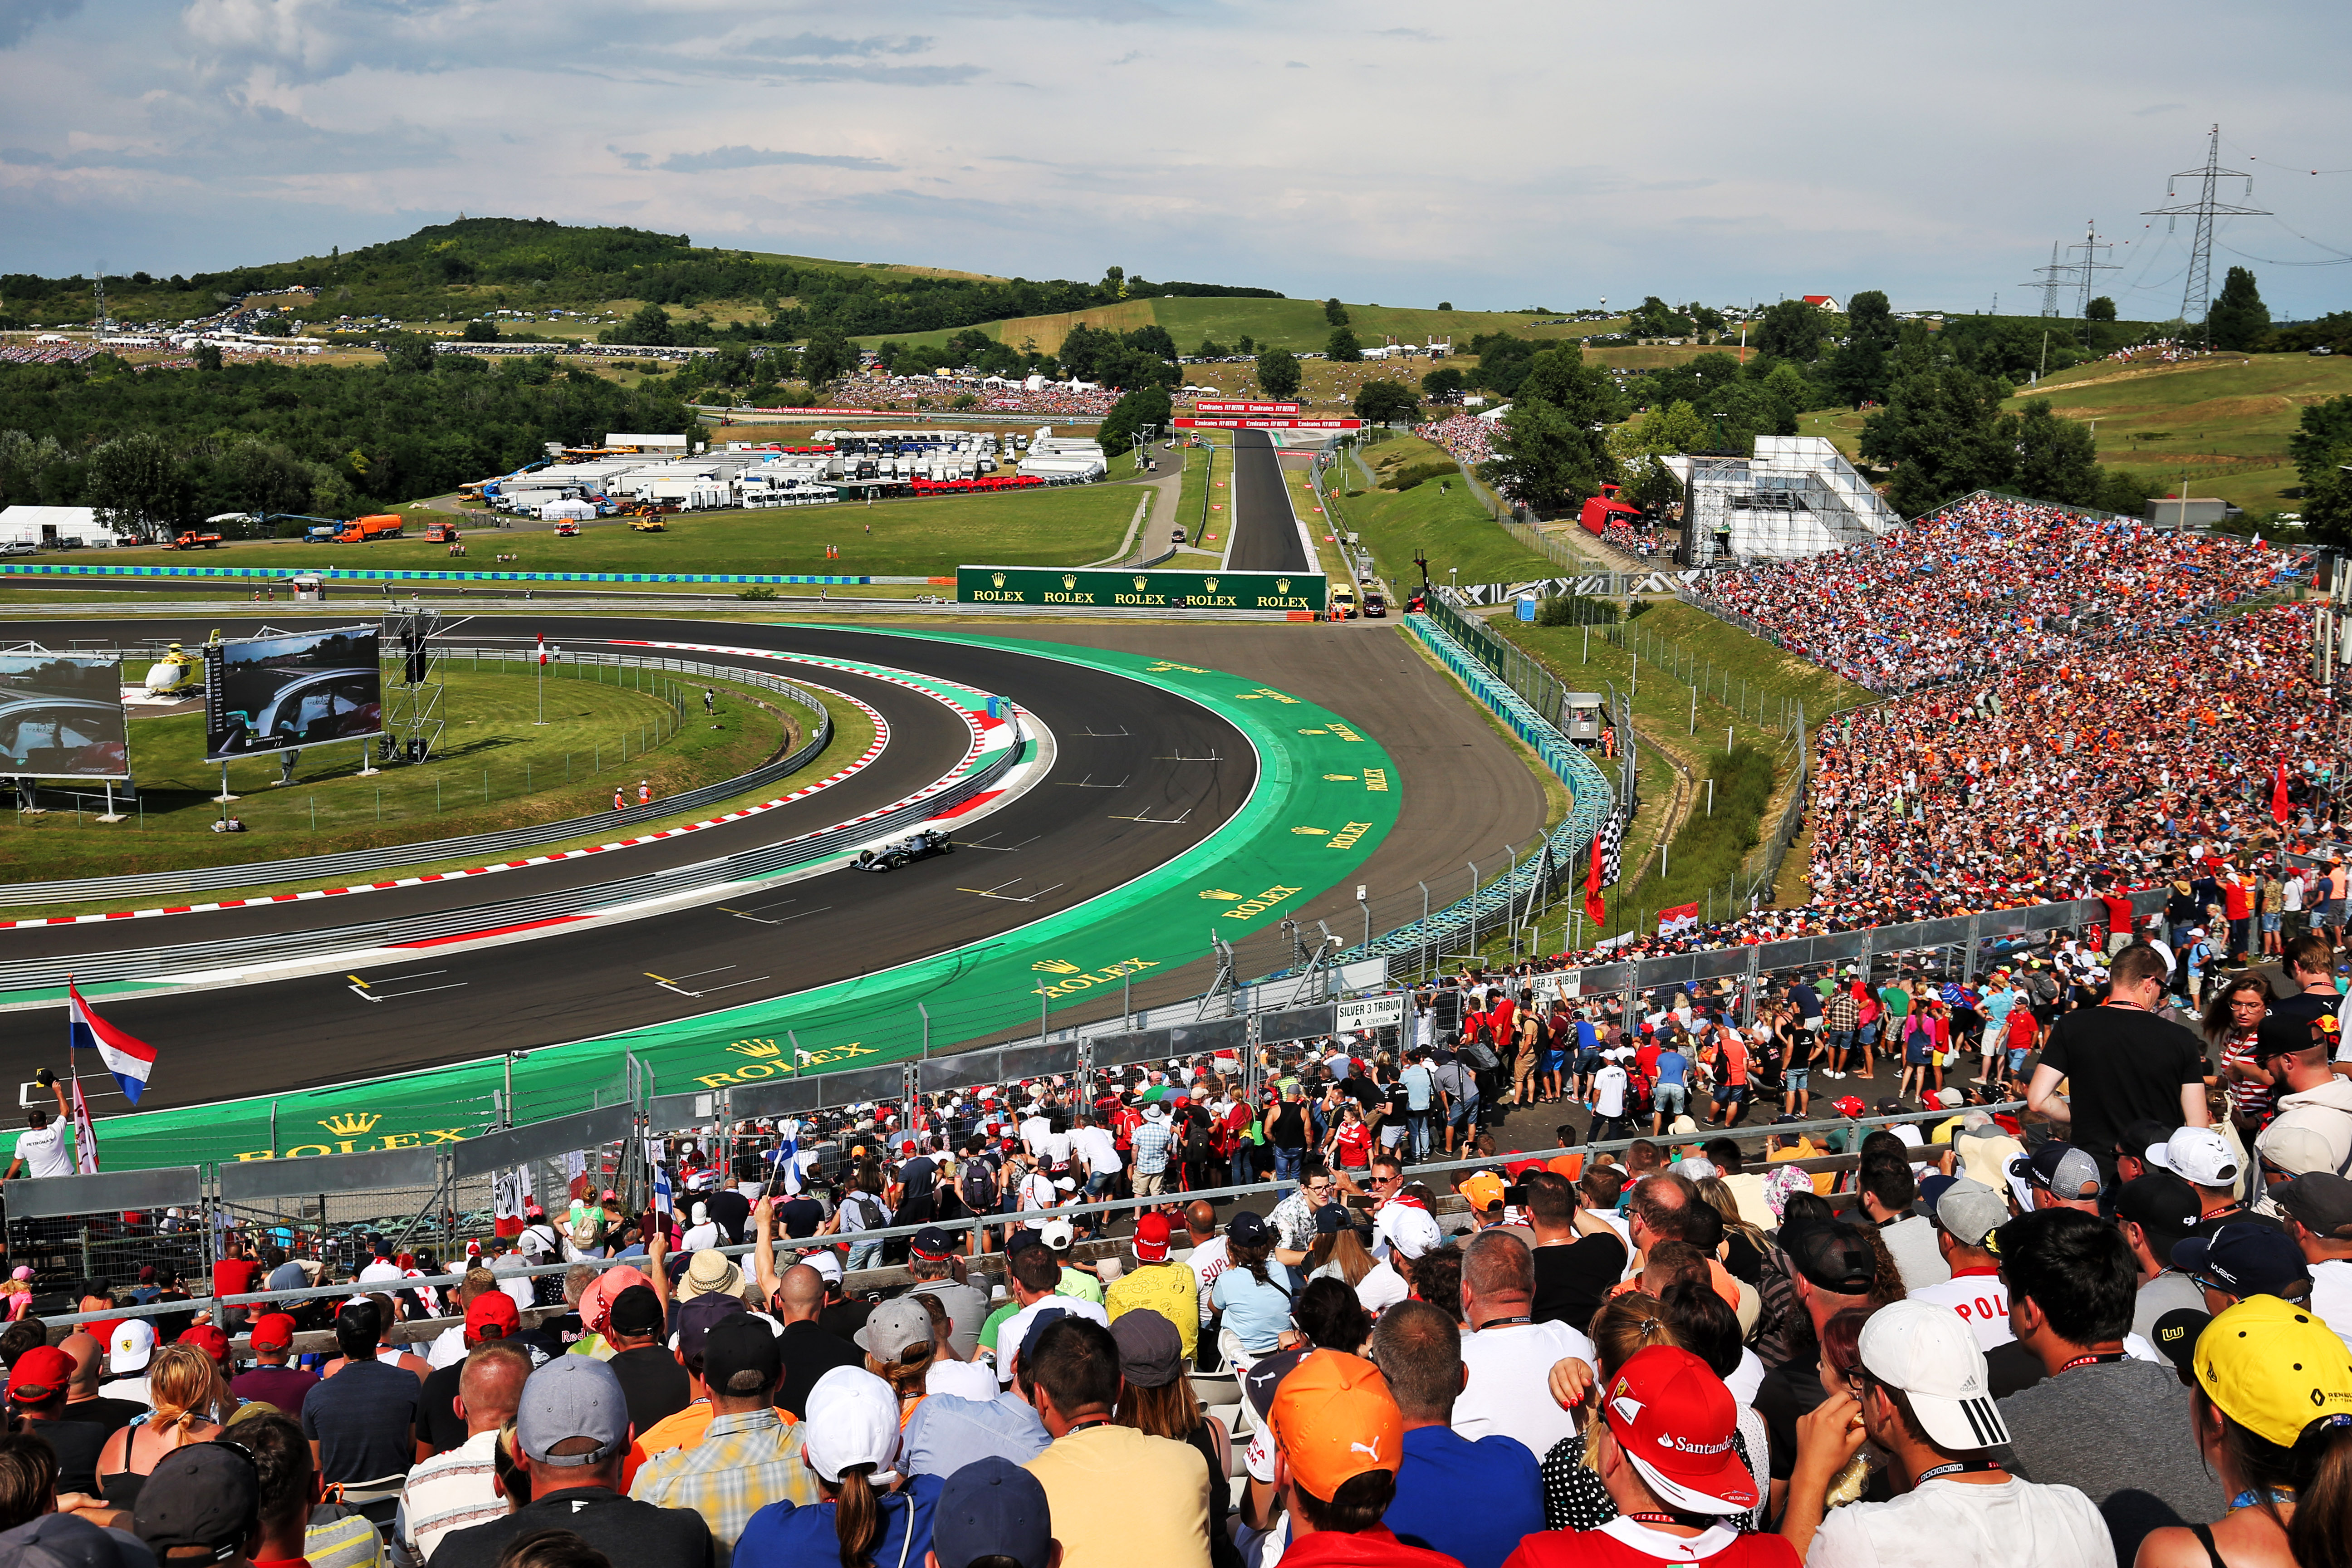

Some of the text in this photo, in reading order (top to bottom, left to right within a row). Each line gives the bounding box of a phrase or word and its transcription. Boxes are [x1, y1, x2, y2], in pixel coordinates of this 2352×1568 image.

[973, 590, 1024, 601] ROLEX
[1044, 592, 1095, 603] ROLEX
[1115, 593, 1166, 604] ROLEX
[1186, 595, 1237, 606] ROLEX
[1257, 596, 1308, 608] ROLEX
[1490, 661, 1498, 675] ROLEX
[1252, 688, 1301, 704] ROLEX
[1325, 723, 1364, 742] ROLEX
[1363, 768, 1389, 792] ROLEX
[1326, 821, 1372, 850] ROLEX
[1221, 885, 1303, 920] ROLEX
[1031, 957, 1160, 999] ROLEX
[1548, 978, 1552, 987] 3
[1340, 998, 1400, 1018] SILVER 3 TRIBÜN
[1354, 1016, 1389, 1027] A SZEKTOR
[693, 1042, 879, 1088] ROLEX
[26, 1137, 54, 1147] PETRONAS
[2211, 1262, 2237, 1284] WRC
[562, 1328, 586, 1343] Red
